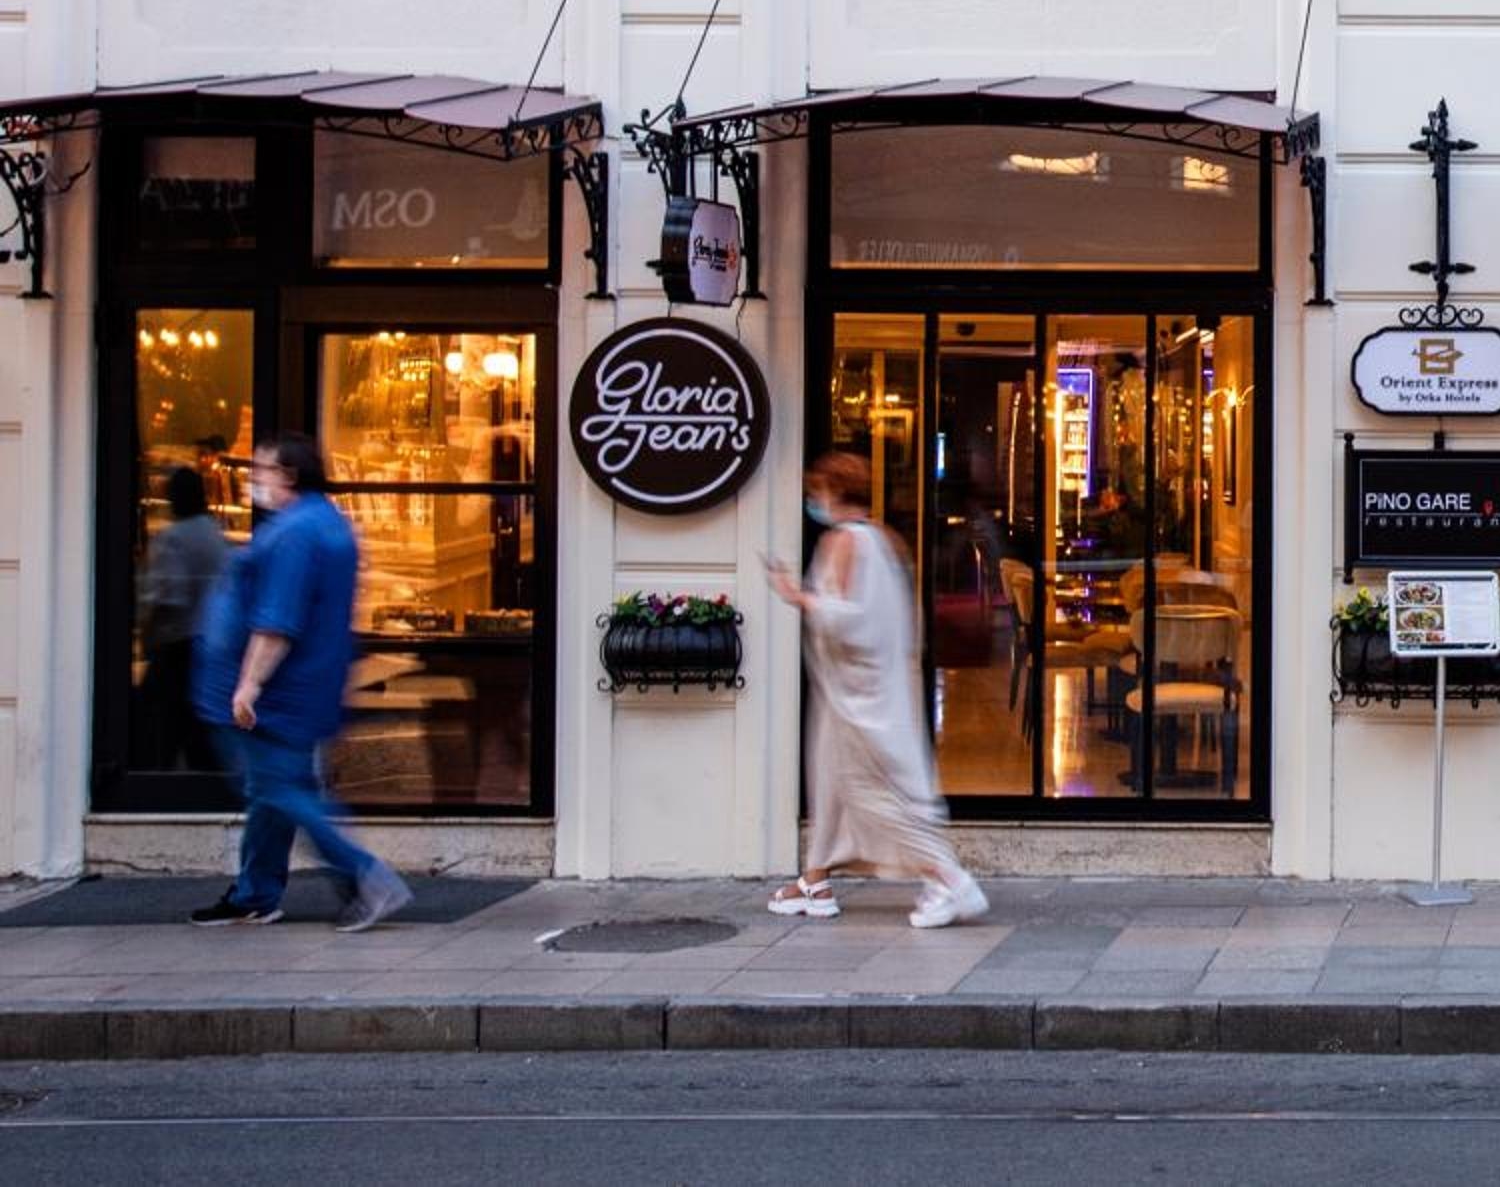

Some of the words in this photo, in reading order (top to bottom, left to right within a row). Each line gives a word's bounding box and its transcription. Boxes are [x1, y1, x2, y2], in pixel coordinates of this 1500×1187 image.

[586, 361, 739, 431] Gloria
[1380, 375, 1432, 389] Orient
[1437, 376, 1499, 393] Express
[598, 423, 750, 473] Jean's
[1416, 492, 1471, 510] GARE
